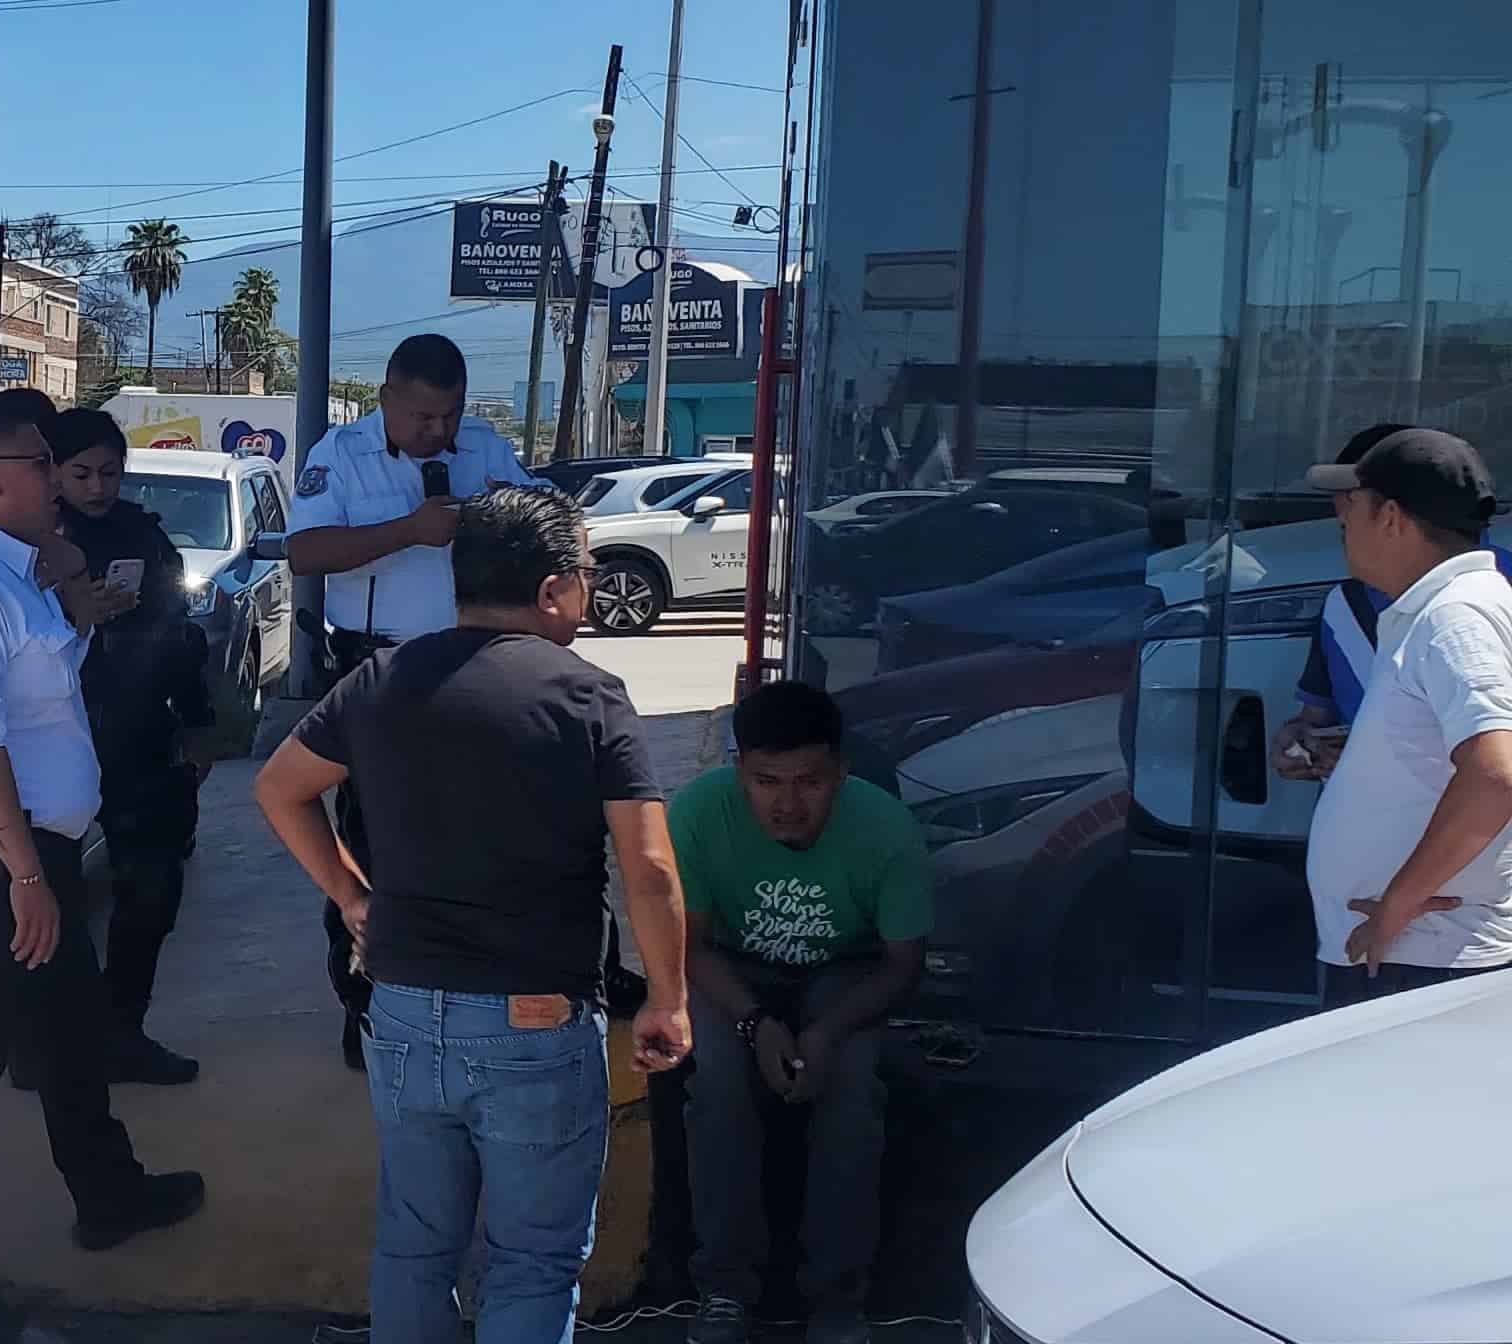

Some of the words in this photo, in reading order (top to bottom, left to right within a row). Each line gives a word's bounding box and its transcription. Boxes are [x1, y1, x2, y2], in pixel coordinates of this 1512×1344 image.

[460, 242, 562, 258] BAÑOVENA
[671, 269, 693, 279] UGO
[621, 299, 722, 323] BAÑVENTA
[711, 552, 746, 560] NISS
